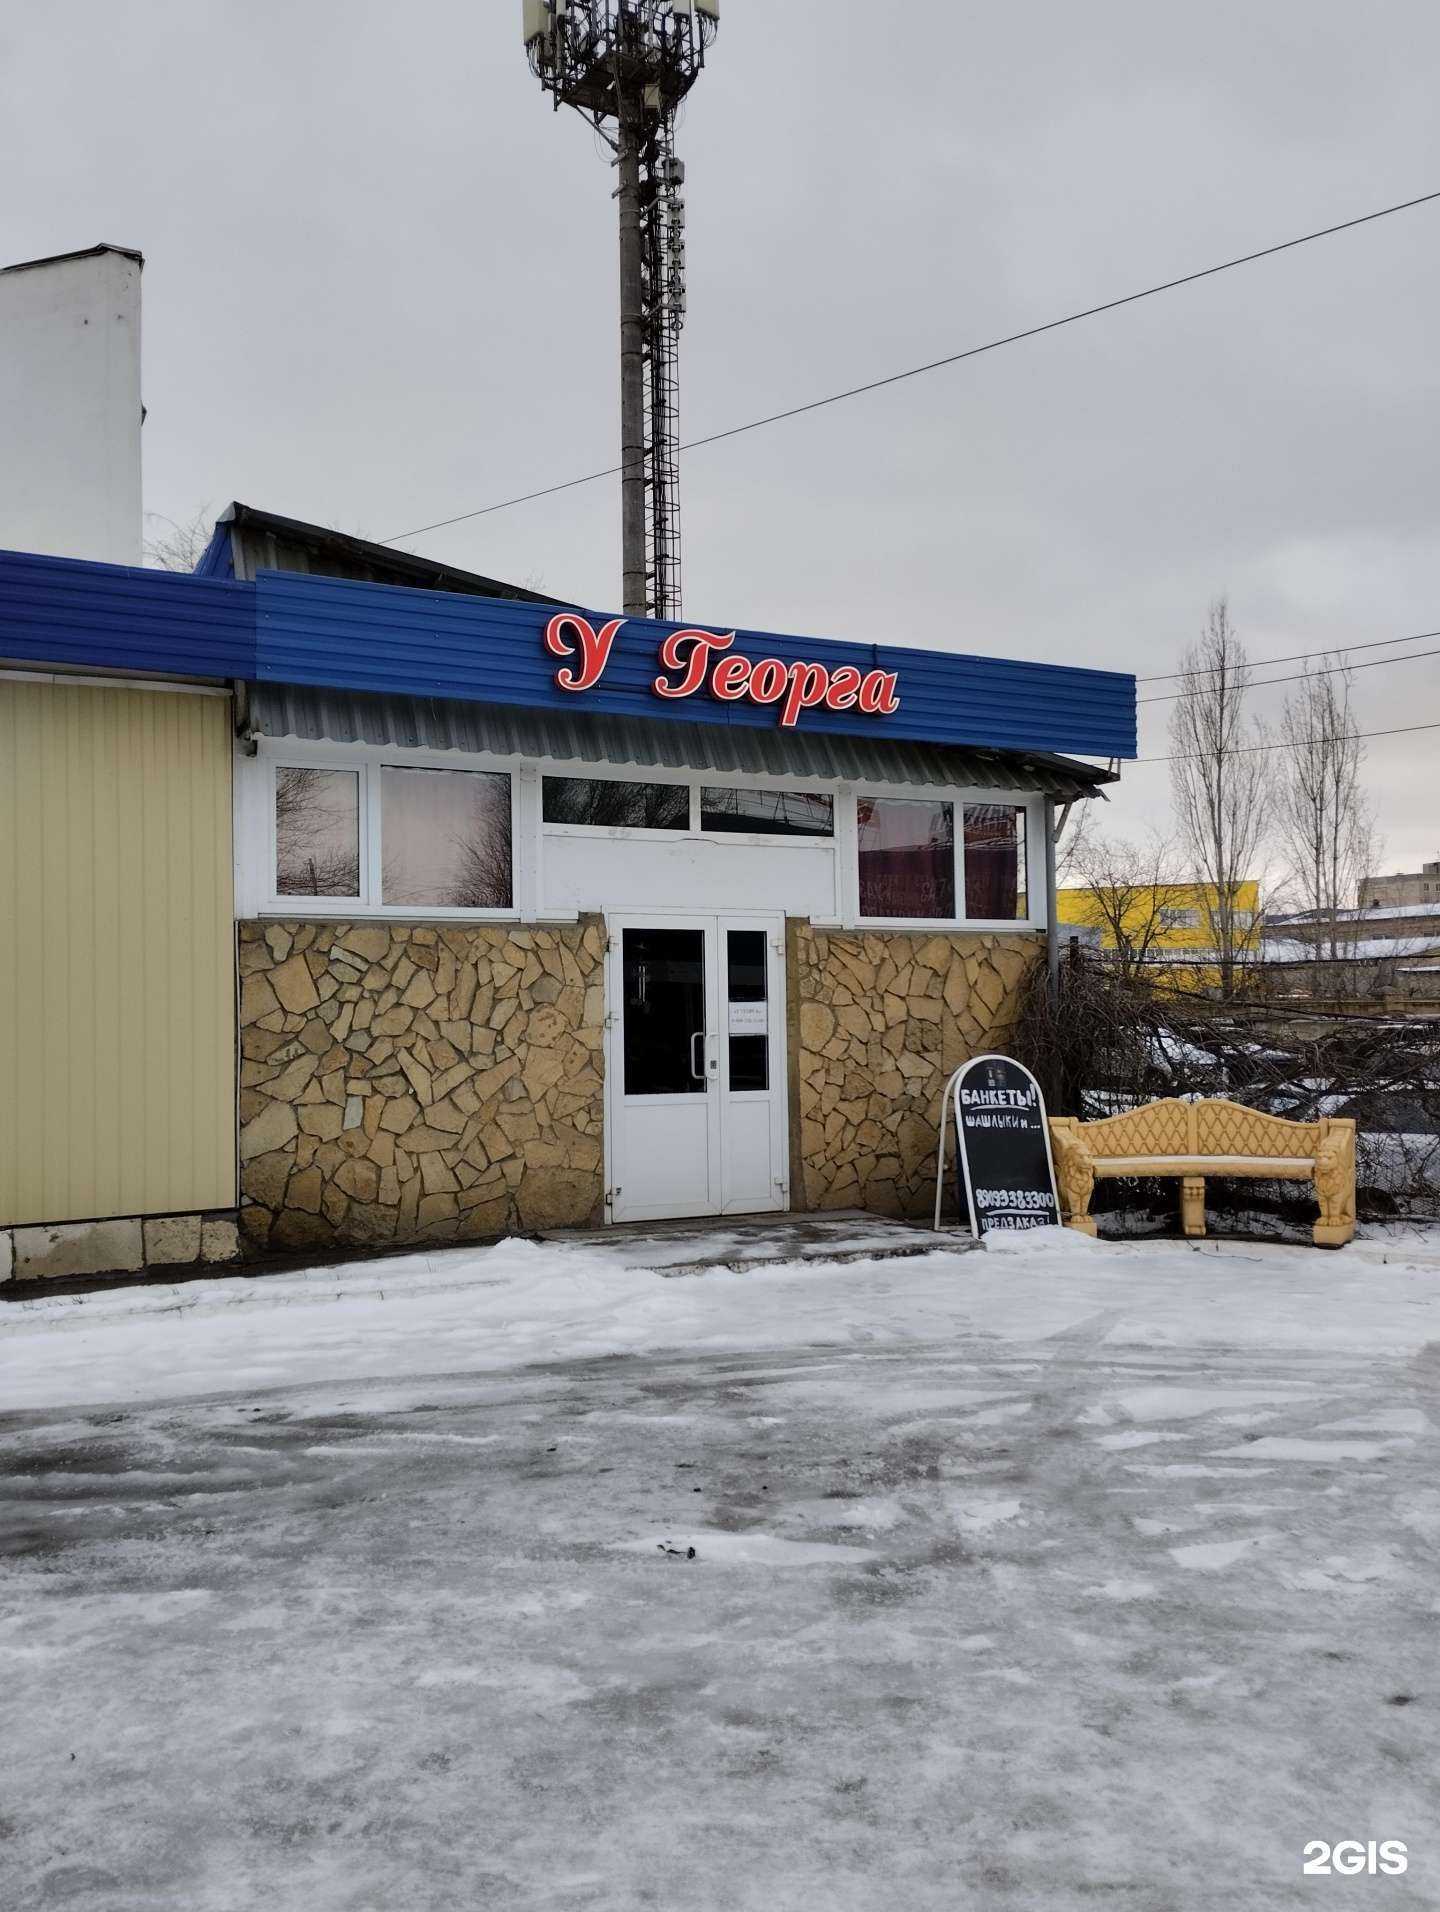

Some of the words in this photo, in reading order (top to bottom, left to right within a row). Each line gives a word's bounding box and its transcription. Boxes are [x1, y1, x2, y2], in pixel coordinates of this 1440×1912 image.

[545, 613, 629, 691] У
[654, 629, 901, 728] Георга
[961, 1084, 1037, 1107] БАНКЕТЫ!
[965, 1115, 1019, 1129] ШАШЛЫКИ
